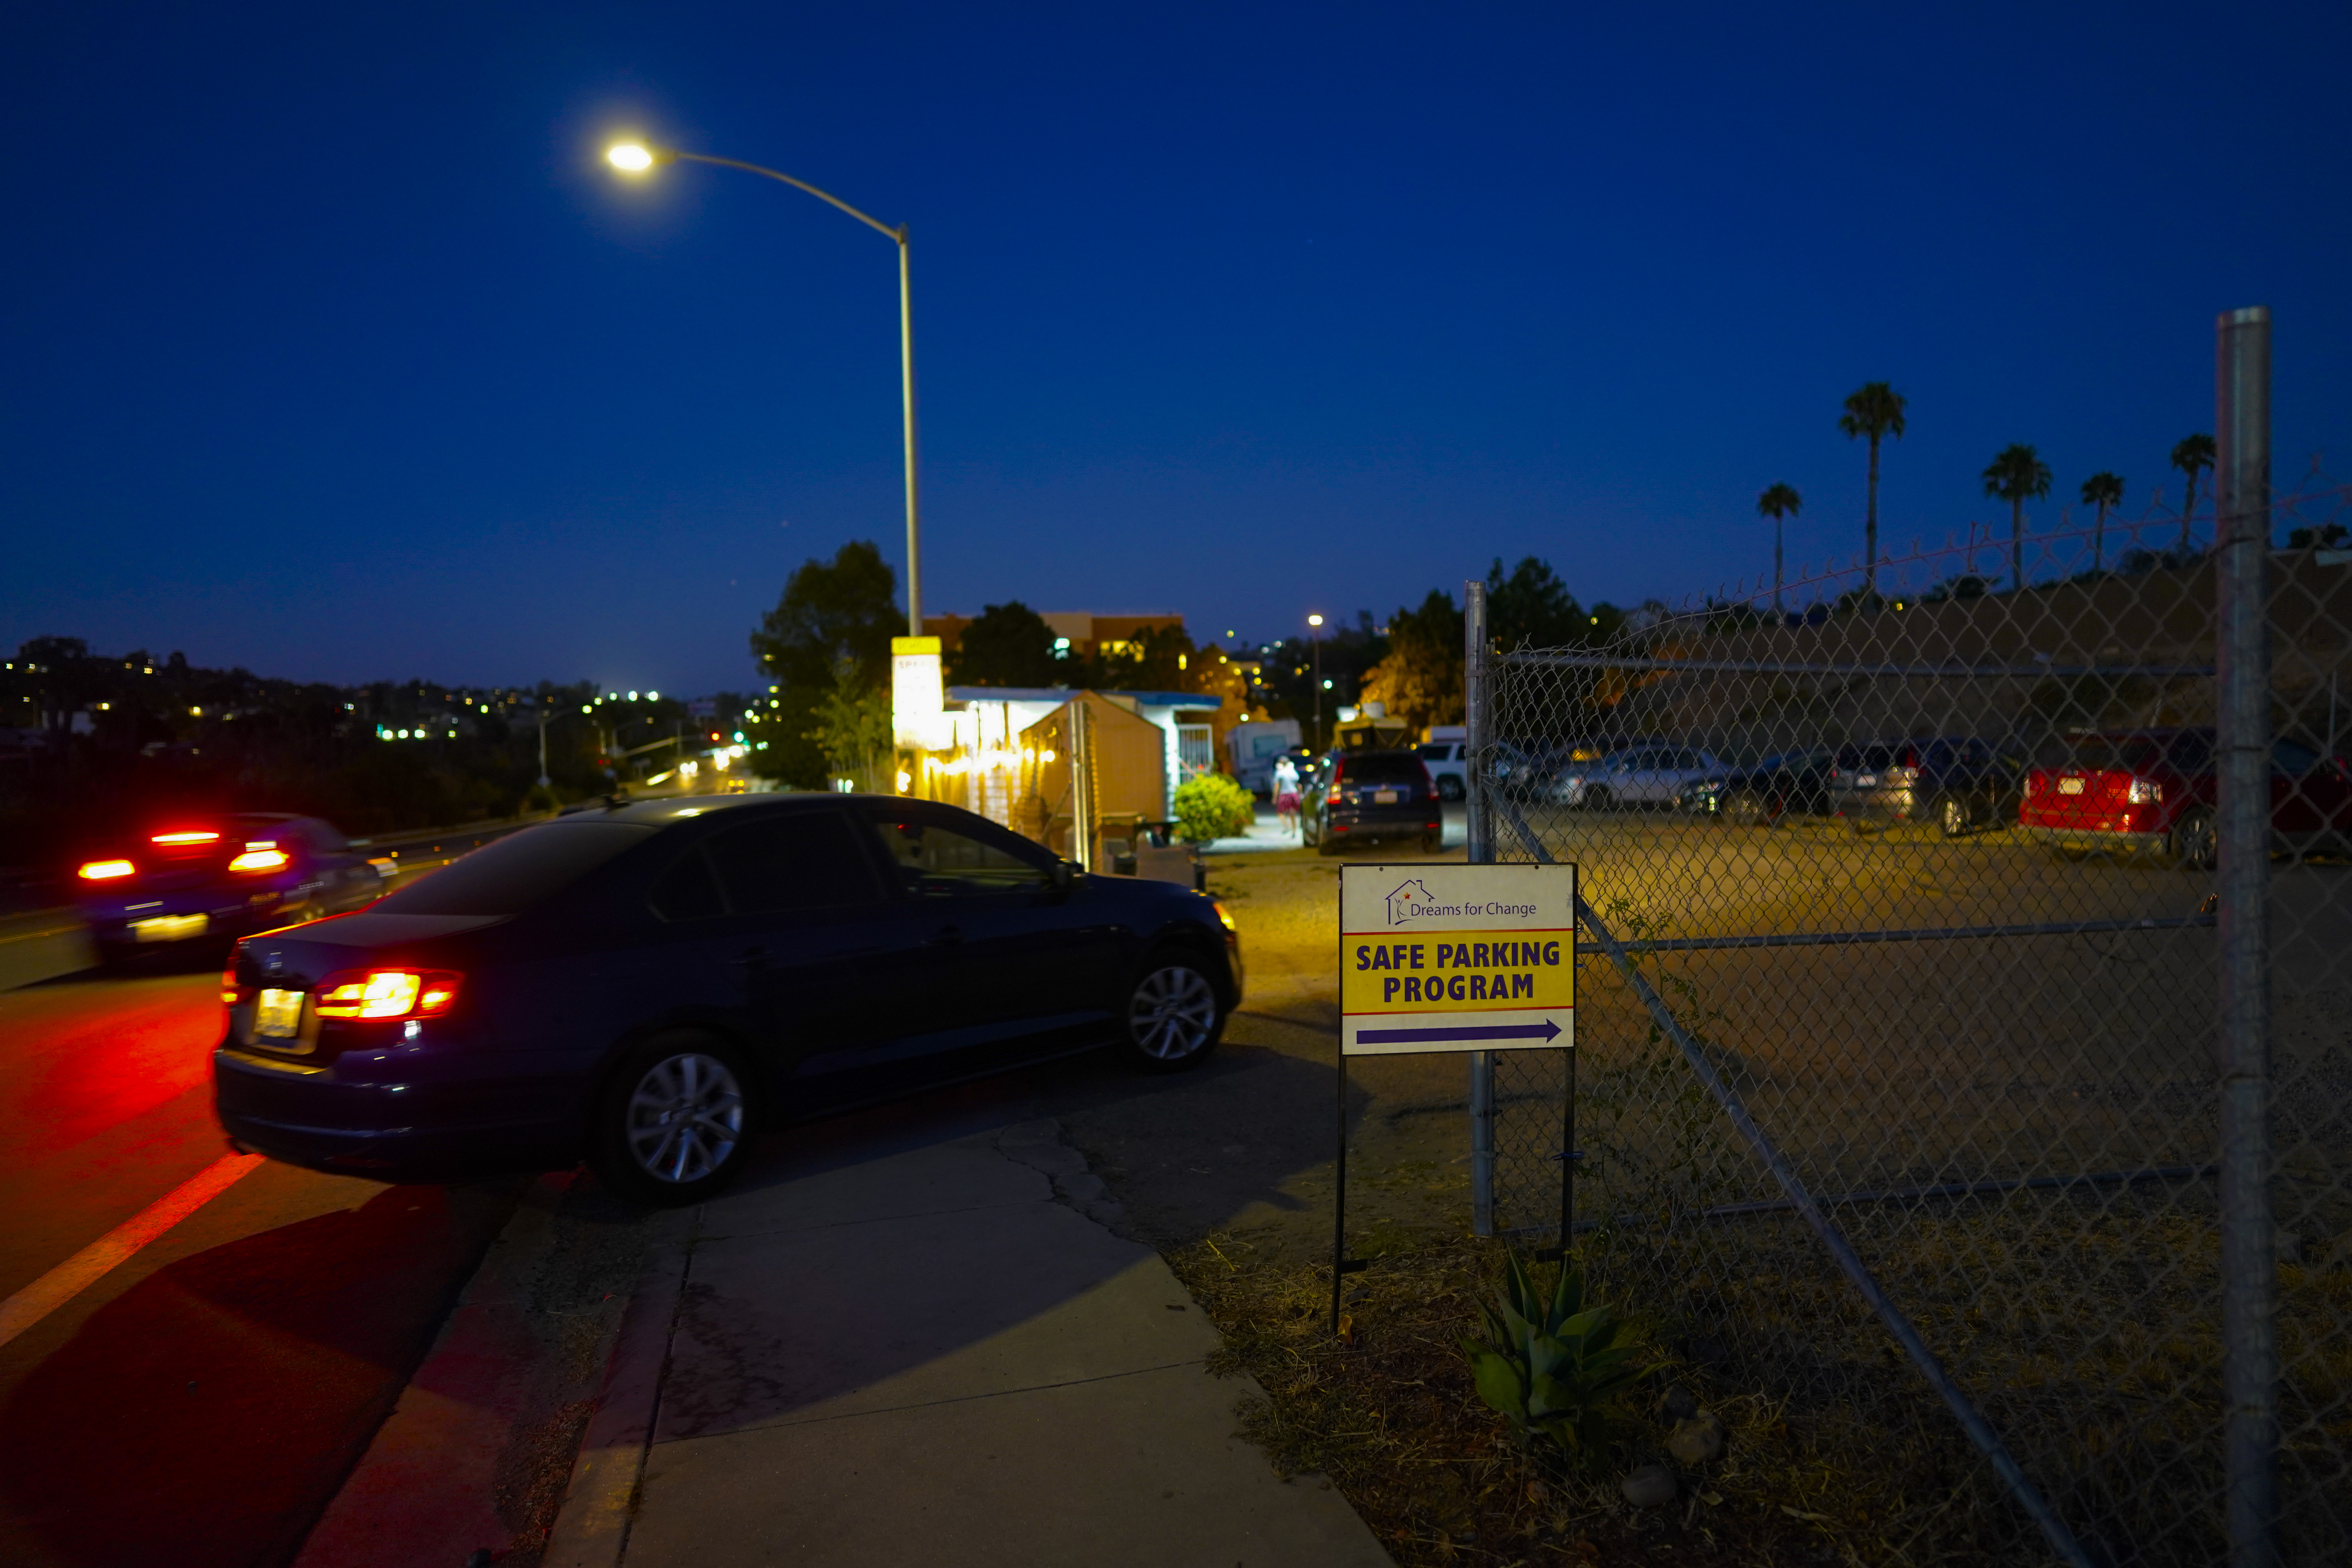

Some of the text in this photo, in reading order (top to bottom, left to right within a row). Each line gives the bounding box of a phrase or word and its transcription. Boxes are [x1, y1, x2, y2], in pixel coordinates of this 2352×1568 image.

[1411, 902, 1536, 918] Dreams for Change
[1356, 941, 1559, 971] SAFE PARKING
[1384, 974, 1533, 1003] PROGRAM
